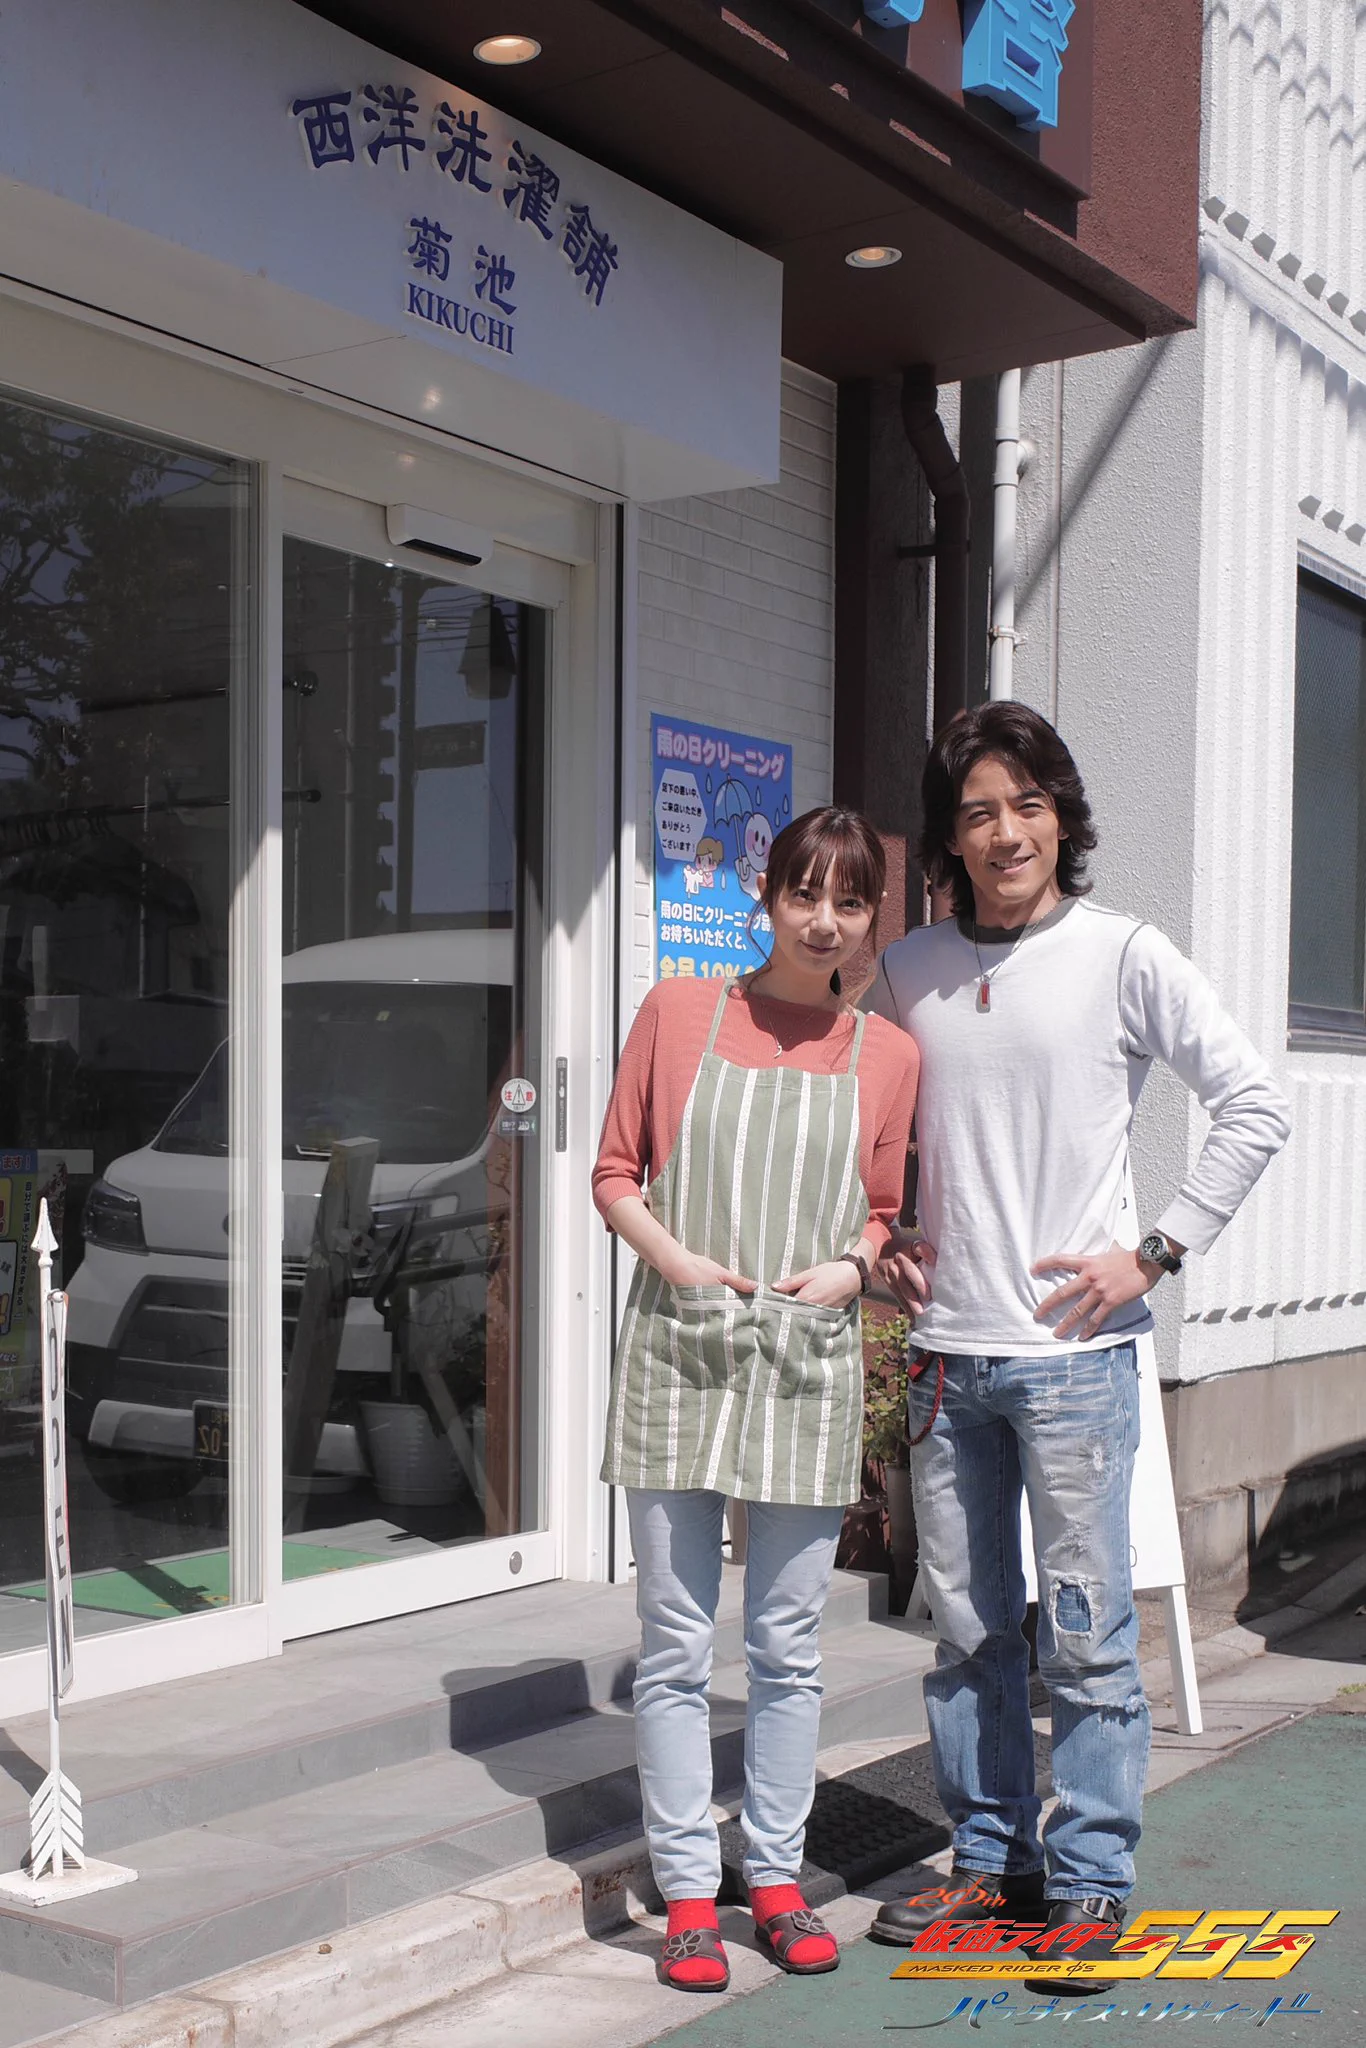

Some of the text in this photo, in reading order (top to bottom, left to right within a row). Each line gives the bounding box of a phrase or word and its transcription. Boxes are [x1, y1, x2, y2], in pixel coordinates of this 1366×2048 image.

[407, 217, 516, 316] 菊池
[407, 283, 514, 354] KIKUCHI
[657, 726, 785, 781] 雨の日クリーニング
[661, 820, 691, 834] ありがとう
[660, 924, 747, 951] お持ちいただくと、
